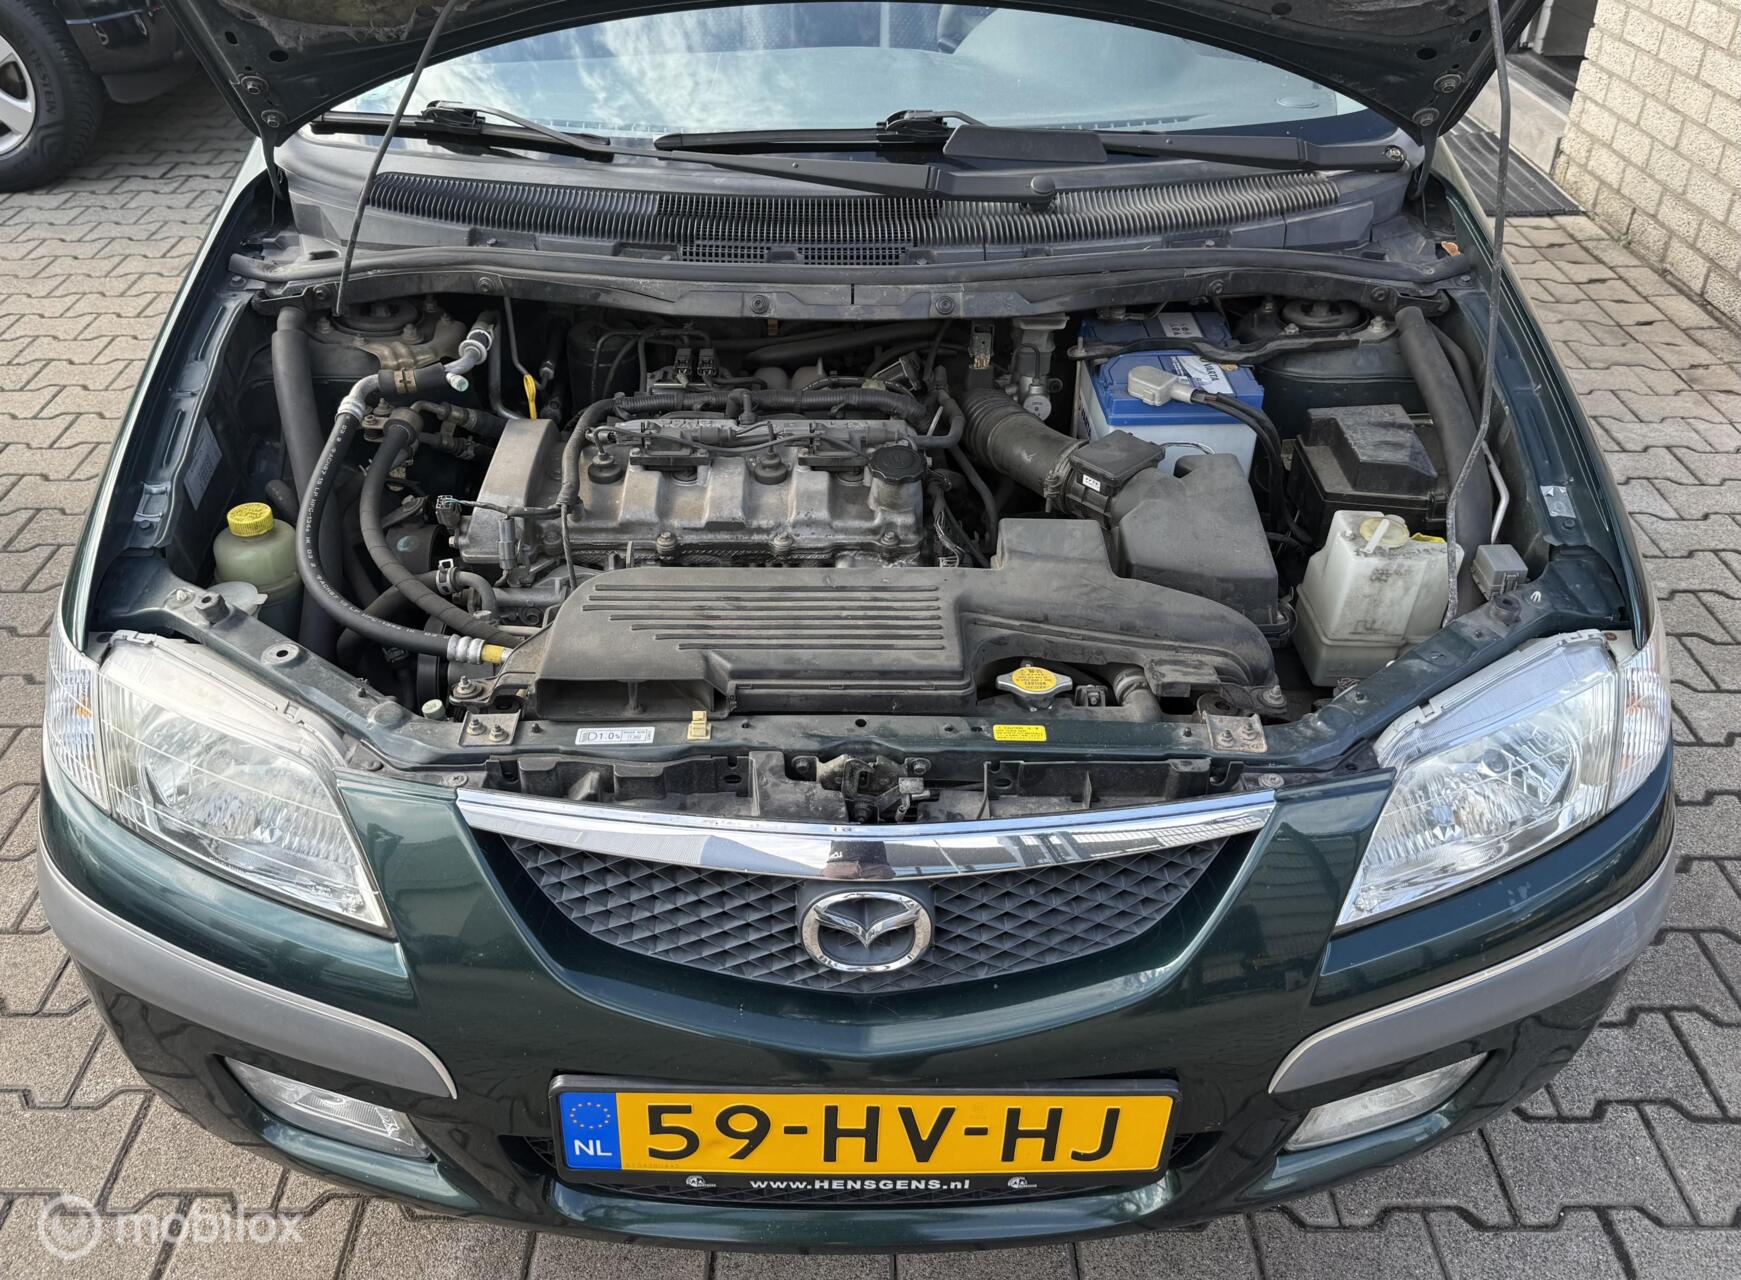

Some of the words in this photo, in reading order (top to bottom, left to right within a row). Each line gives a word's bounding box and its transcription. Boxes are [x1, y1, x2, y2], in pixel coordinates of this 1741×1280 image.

[574, 1139, 612, 1156] NL
[647, 1103, 1121, 1164] 59-HV-HJ
[749, 1178, 970, 1190] www.HENSGENS.nl
